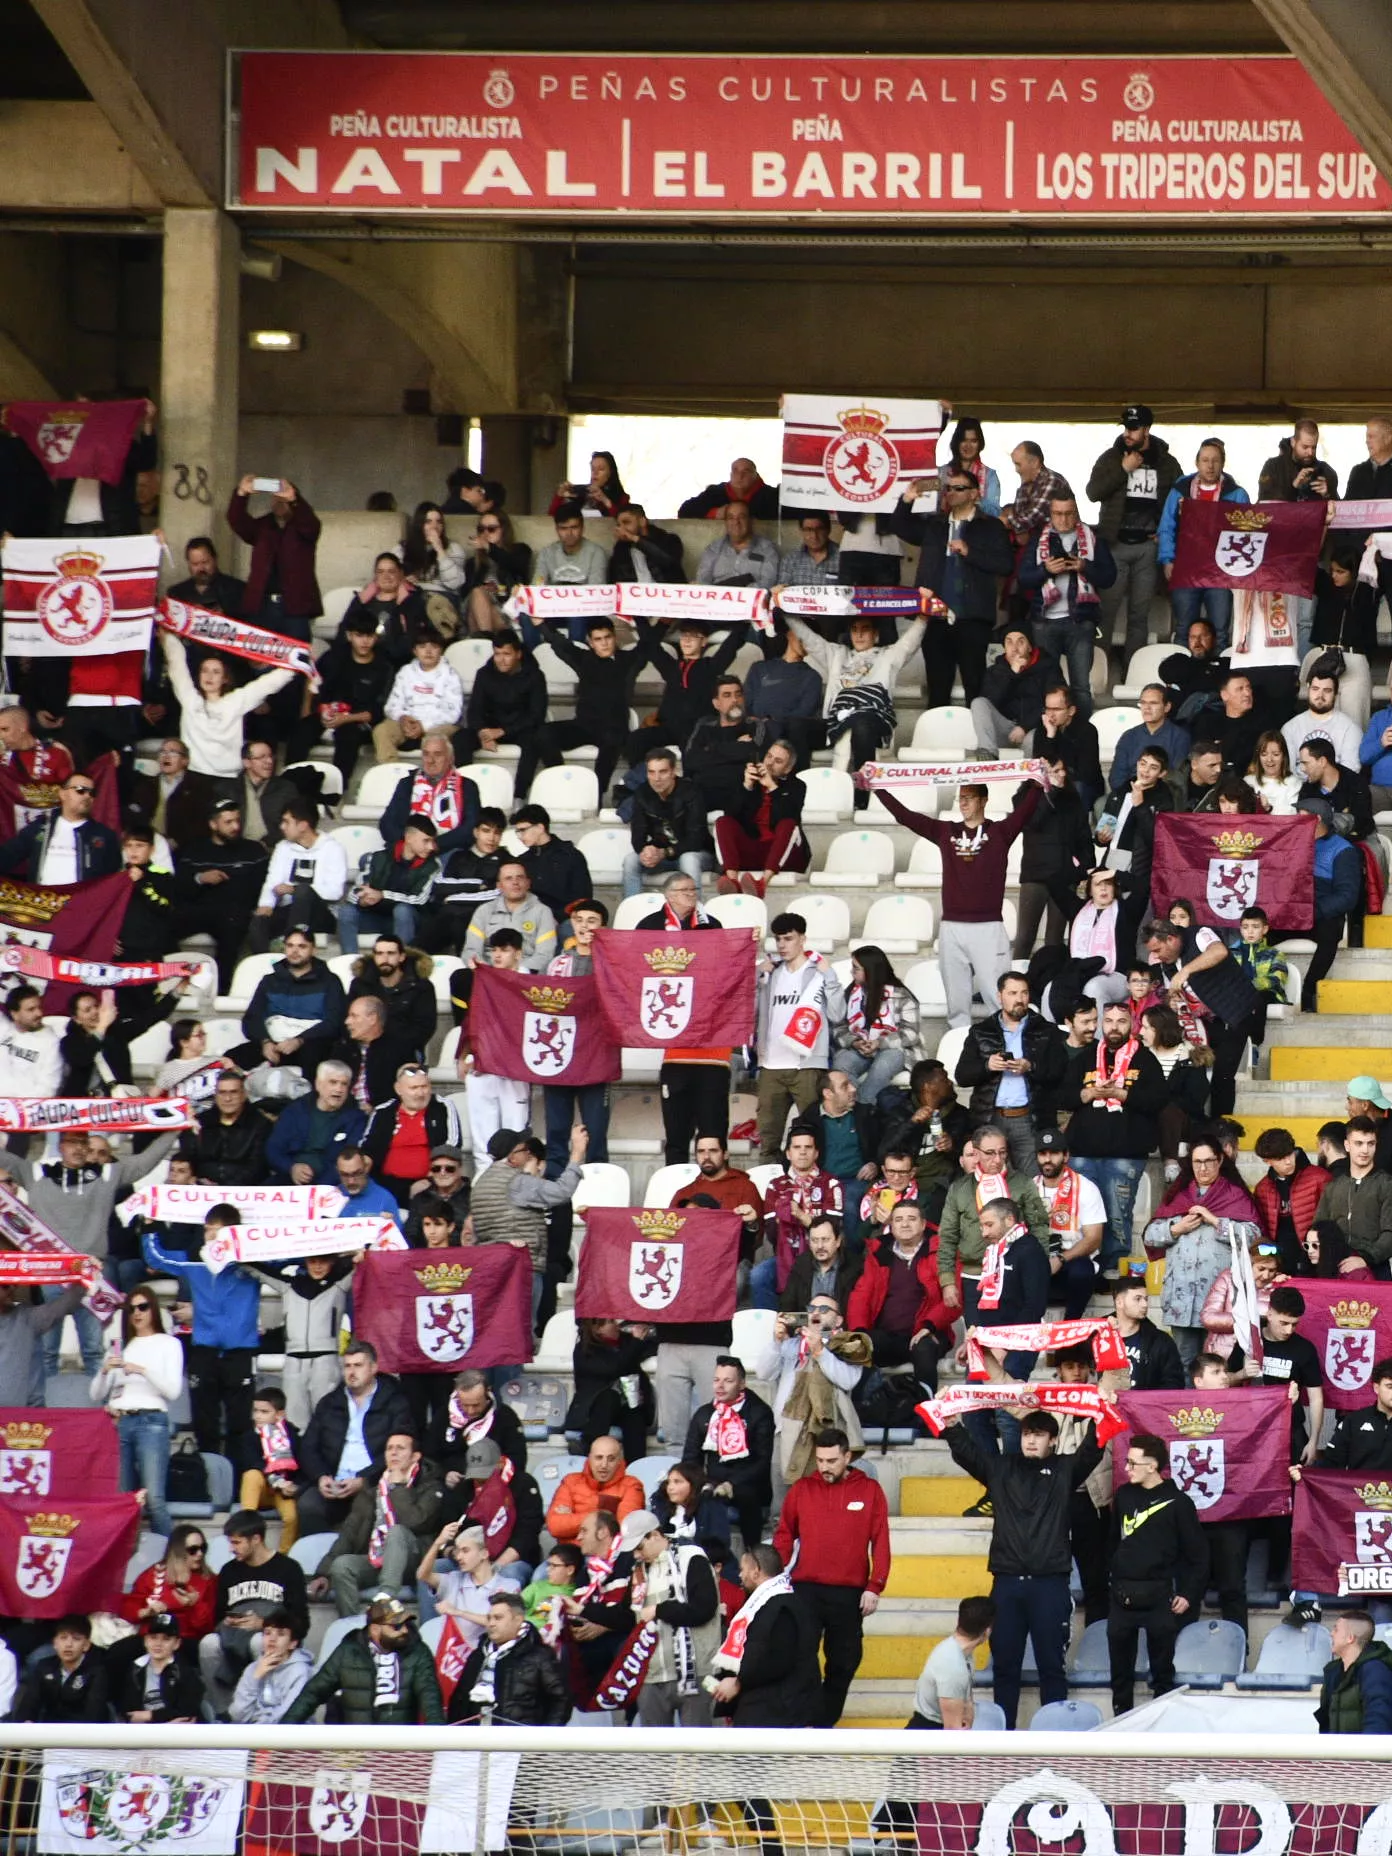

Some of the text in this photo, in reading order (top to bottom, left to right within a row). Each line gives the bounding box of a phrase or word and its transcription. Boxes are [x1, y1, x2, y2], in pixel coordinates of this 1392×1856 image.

[539, 72, 1099, 102] PEÑAS CULTURALISTAS
[330, 110, 522, 139] PEÑA CULTURALISTA
[792, 113, 843, 142] PEÑA
[1112, 115, 1303, 142] PEÑA CULTURALISTA
[255, 147, 598, 197] NATAL
[653, 151, 982, 199] EL BARRIL
[1036, 153, 1377, 200] LOS TRIPEROS DEL SUR
[629, 586, 748, 603] CULTURAL
[887, 762, 1015, 777] CULTURAL LEONESA
[167, 1189, 300, 1203] CULTURAL
[246, 1219, 377, 1241] CULTURAL
